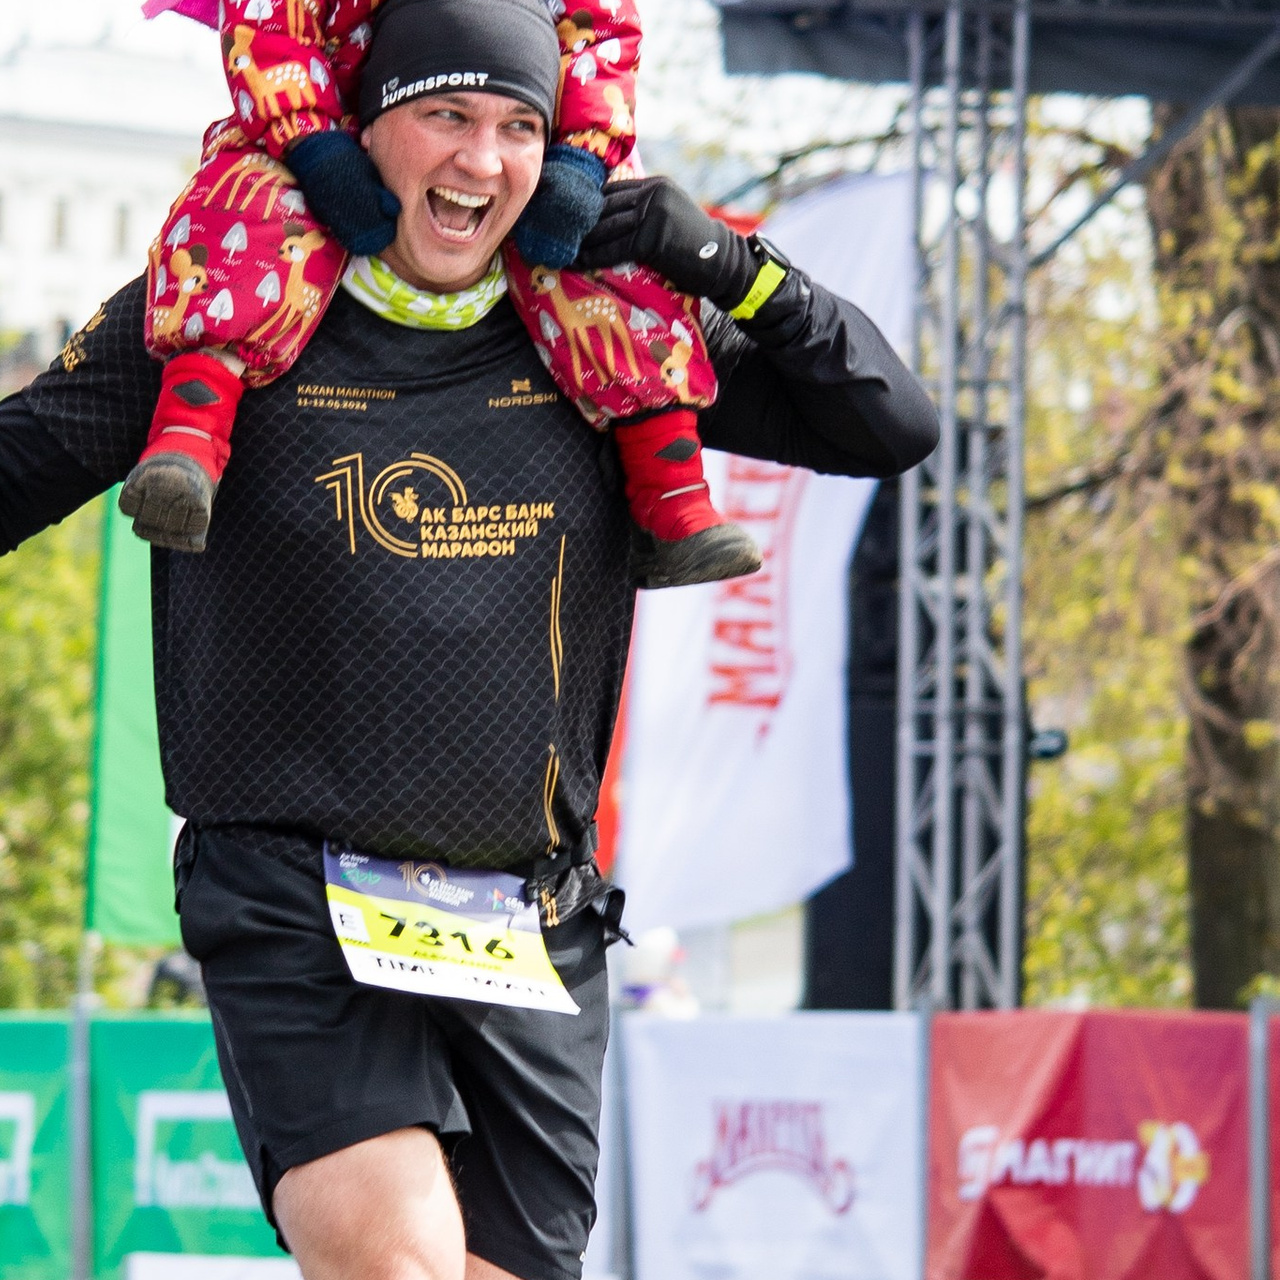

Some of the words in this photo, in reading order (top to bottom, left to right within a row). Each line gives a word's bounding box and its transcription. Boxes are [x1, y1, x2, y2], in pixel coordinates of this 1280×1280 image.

[381, 72, 489, 109] SUPERSPORT
[297, 384, 335, 397] KAZAN
[336, 386, 396, 401] MARATHON
[488, 392, 558, 408] NORDSKI
[315, 452, 468, 559] 10
[420, 507, 447, 524] АК
[451, 505, 501, 524] БАРС
[505, 502, 555, 521] БАНК
[420, 517, 539, 541] КАЗАНСКИЙ
[421, 539, 516, 559] МАРАФОН
